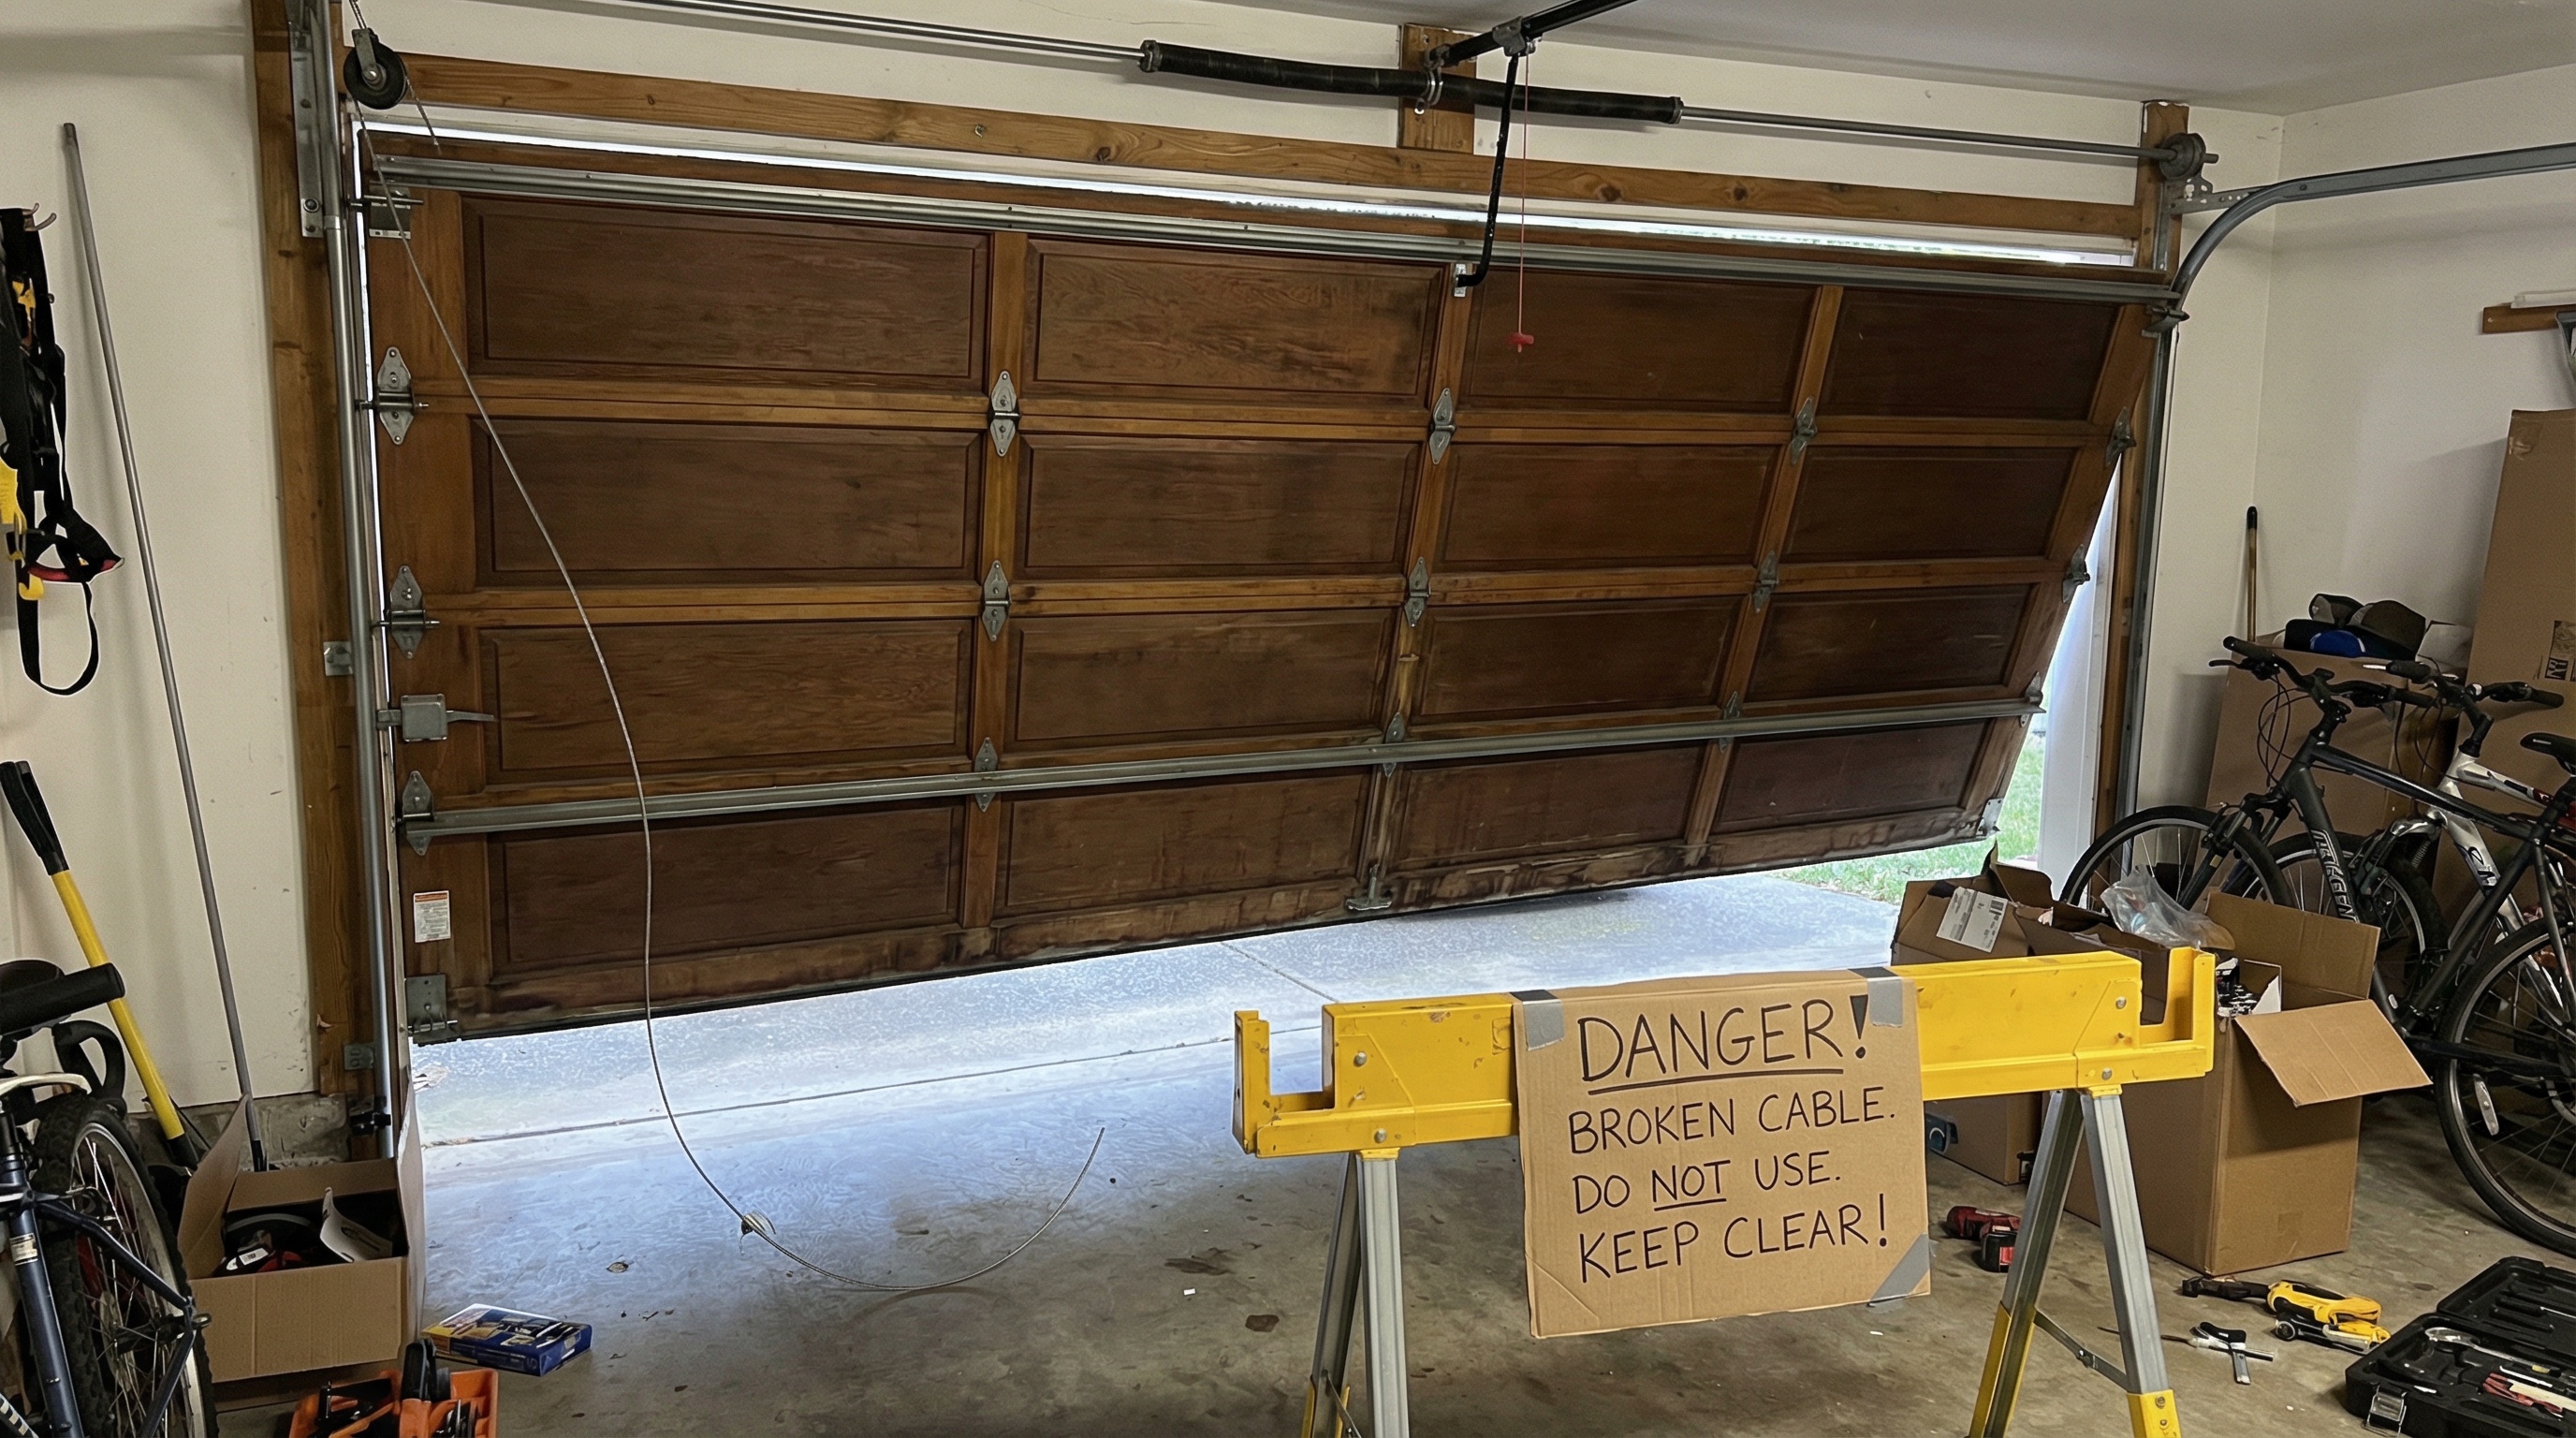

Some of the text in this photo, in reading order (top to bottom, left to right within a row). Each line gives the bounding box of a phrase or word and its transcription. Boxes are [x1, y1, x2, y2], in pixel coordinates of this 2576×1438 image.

[1576, 993, 1869, 1082] DANGER!
[1568, 1086, 1895, 1154] BROKEN CABLE.
[1572, 1150, 1841, 1215] DO NOT USE.
[1579, 1193, 1888, 1284] KEEP CLEAR!
